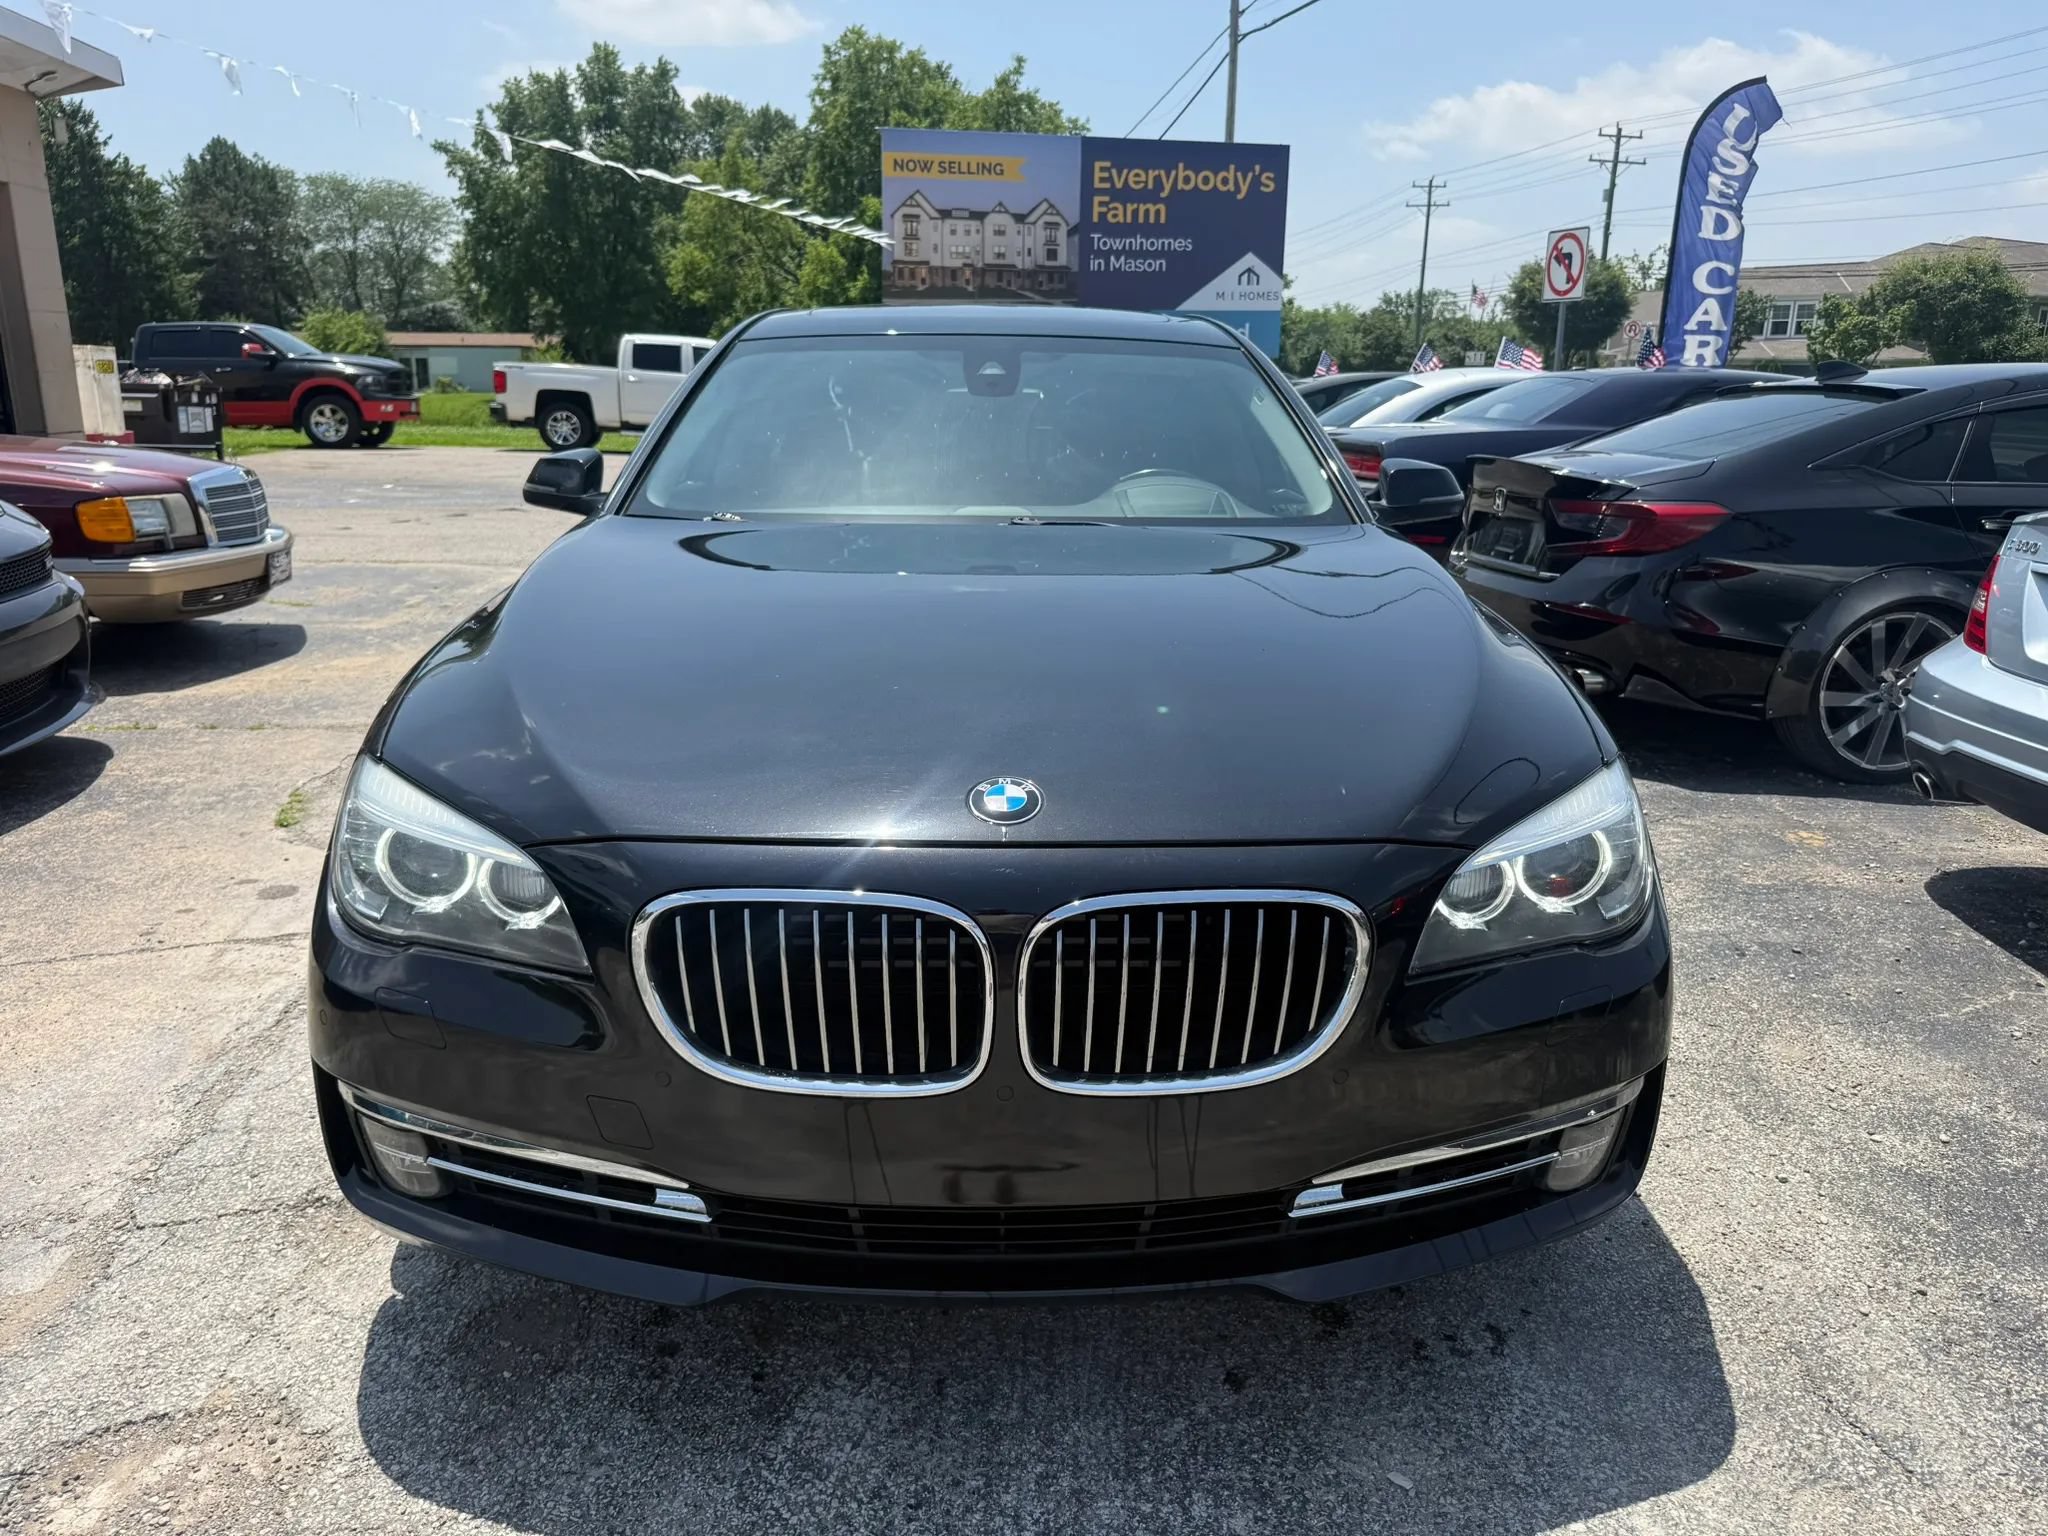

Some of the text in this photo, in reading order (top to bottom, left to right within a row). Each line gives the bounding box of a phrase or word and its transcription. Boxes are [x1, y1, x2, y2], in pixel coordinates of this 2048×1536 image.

[892, 158, 1005, 176] NOW SELLING
[1093, 161, 1276, 200] Everybody's
[1092, 195, 1167, 224] Farm
[1090, 233, 1193, 251] Townhomes
[1680, 102, 1758, 367] USED CAR
[1089, 254, 1167, 272] in Mason
[1239, 291, 1280, 301] HOMES
[975, 777, 1034, 792] BMW
